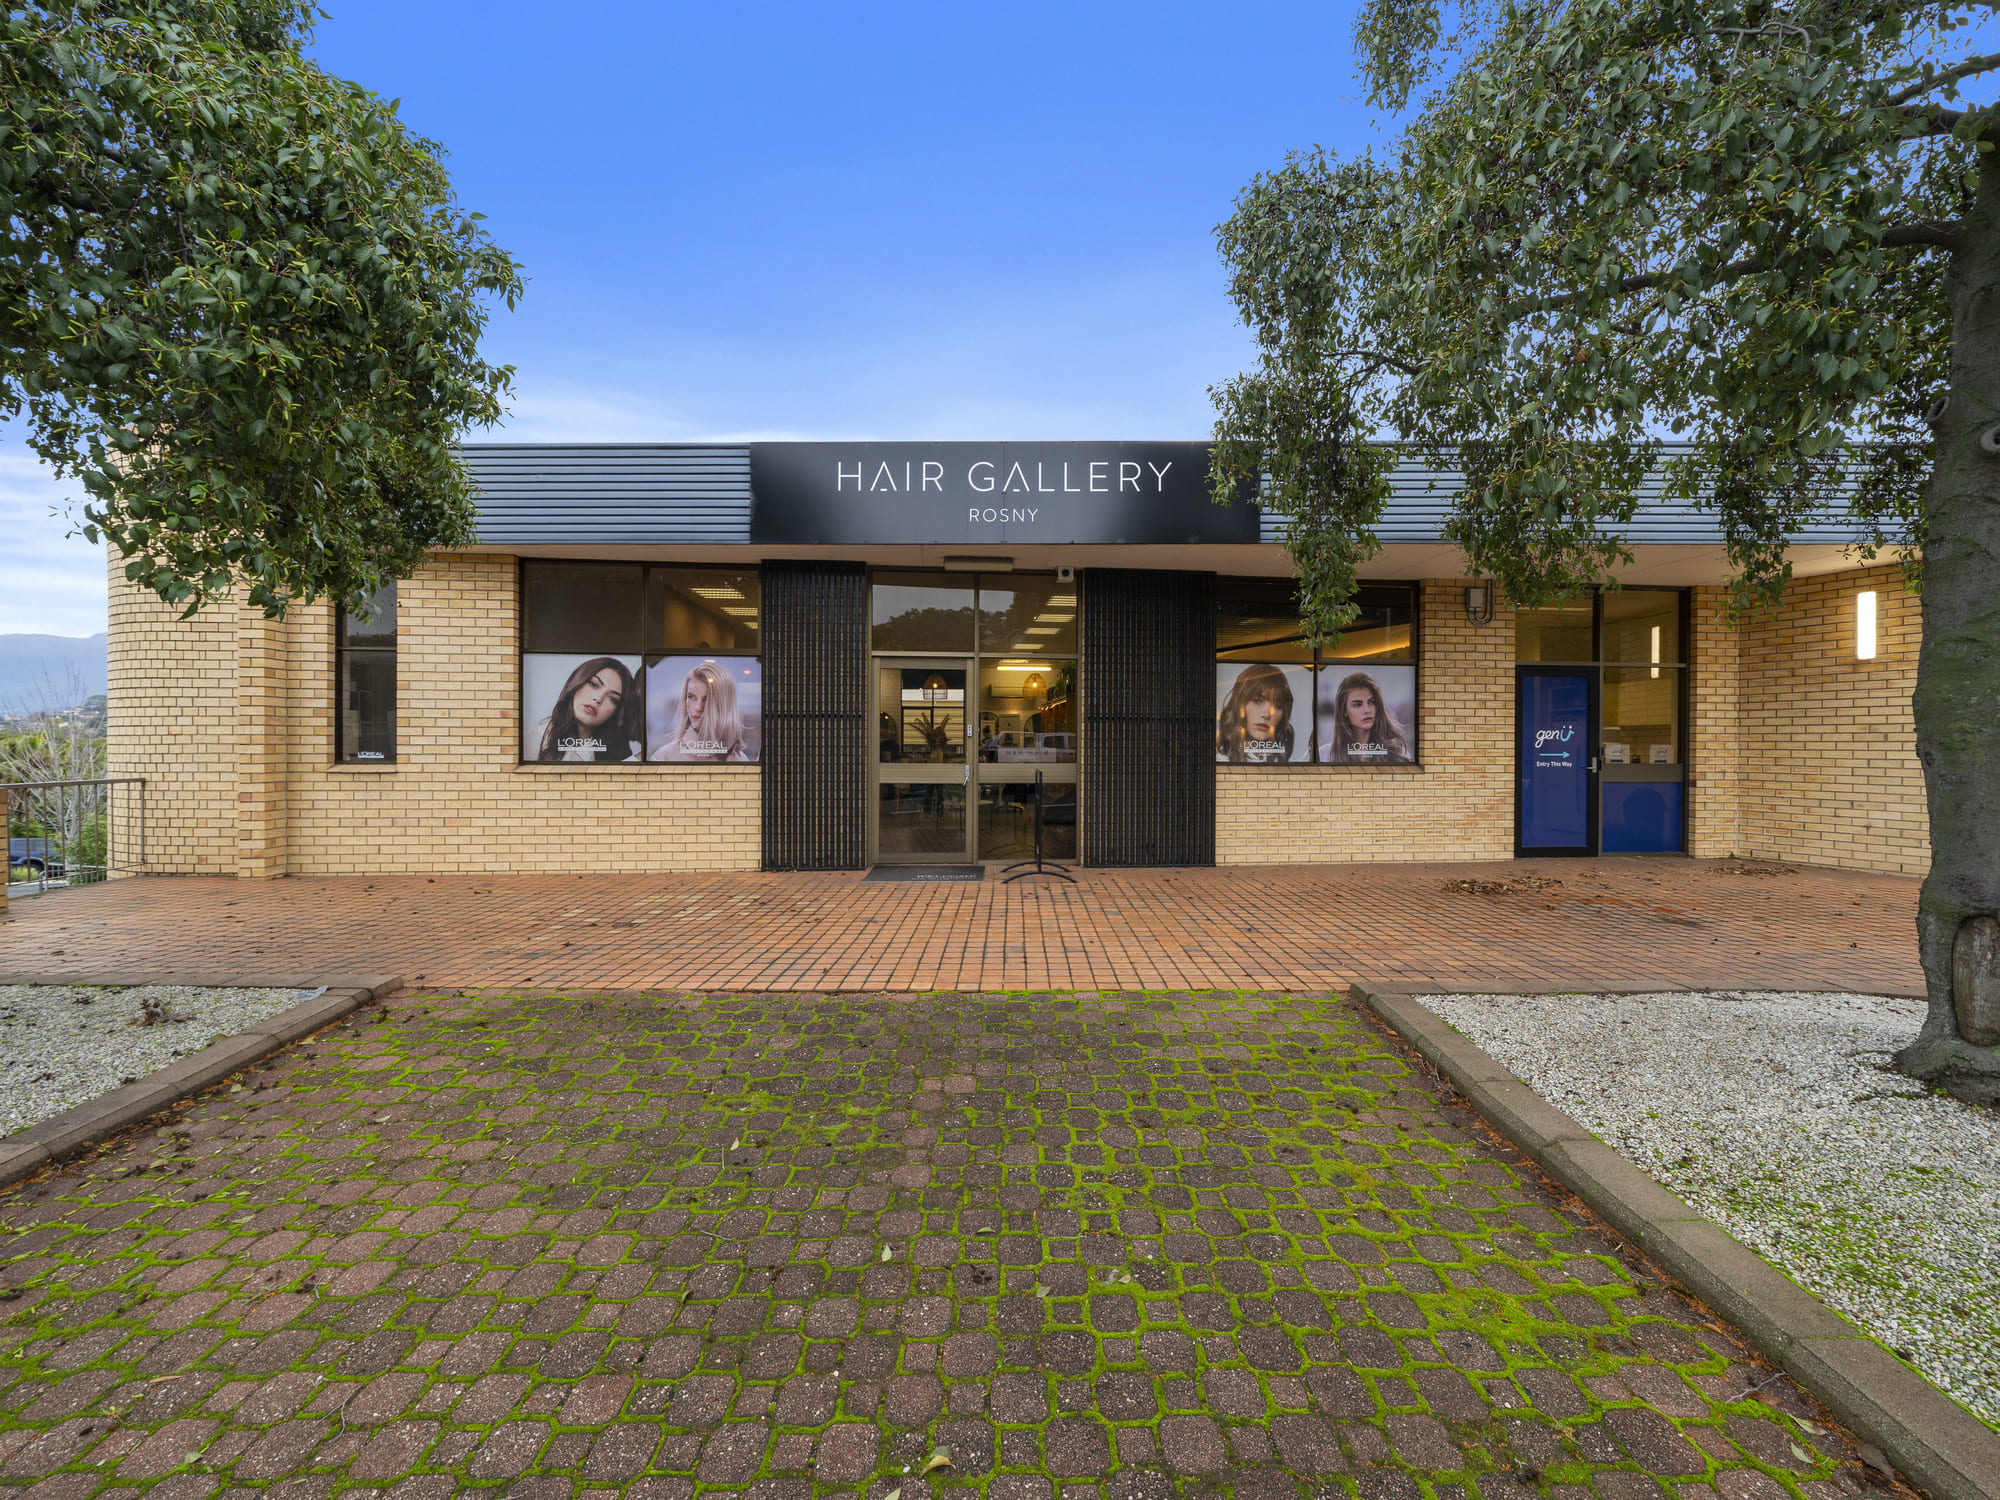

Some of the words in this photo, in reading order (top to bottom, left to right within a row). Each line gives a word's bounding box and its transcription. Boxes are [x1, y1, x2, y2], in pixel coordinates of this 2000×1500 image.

[837, 461, 944, 492] HAIR
[968, 461, 1173, 492] GALLERY
[969, 508, 1039, 522] ROSNY
